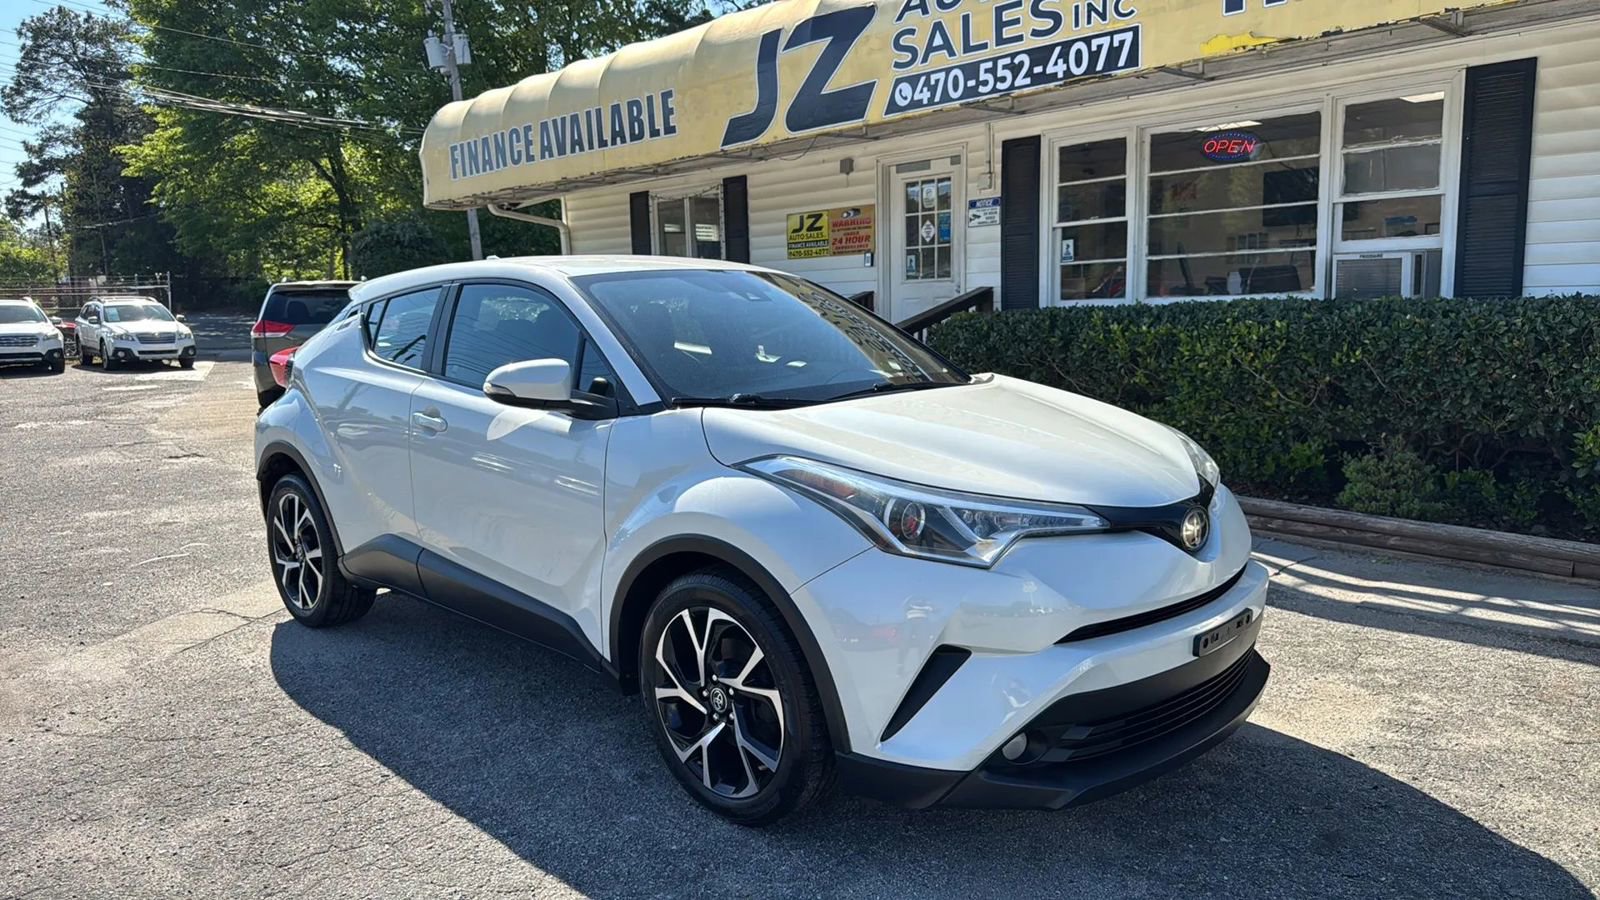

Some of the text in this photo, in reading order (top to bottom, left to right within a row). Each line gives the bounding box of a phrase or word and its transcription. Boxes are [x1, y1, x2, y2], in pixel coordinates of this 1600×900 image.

[892, 0, 1063, 69] SALES
[1073, 0, 1136, 28] INC
[913, 30, 1134, 105] 470-552-4077
[720, 4, 879, 148] JZ
[450, 89, 678, 180] FINANCE AVAILABLE
[1204, 139, 1257, 153] OPEN
[791, 213, 823, 233] JZ
[832, 235, 871, 245] 24 HOUR
